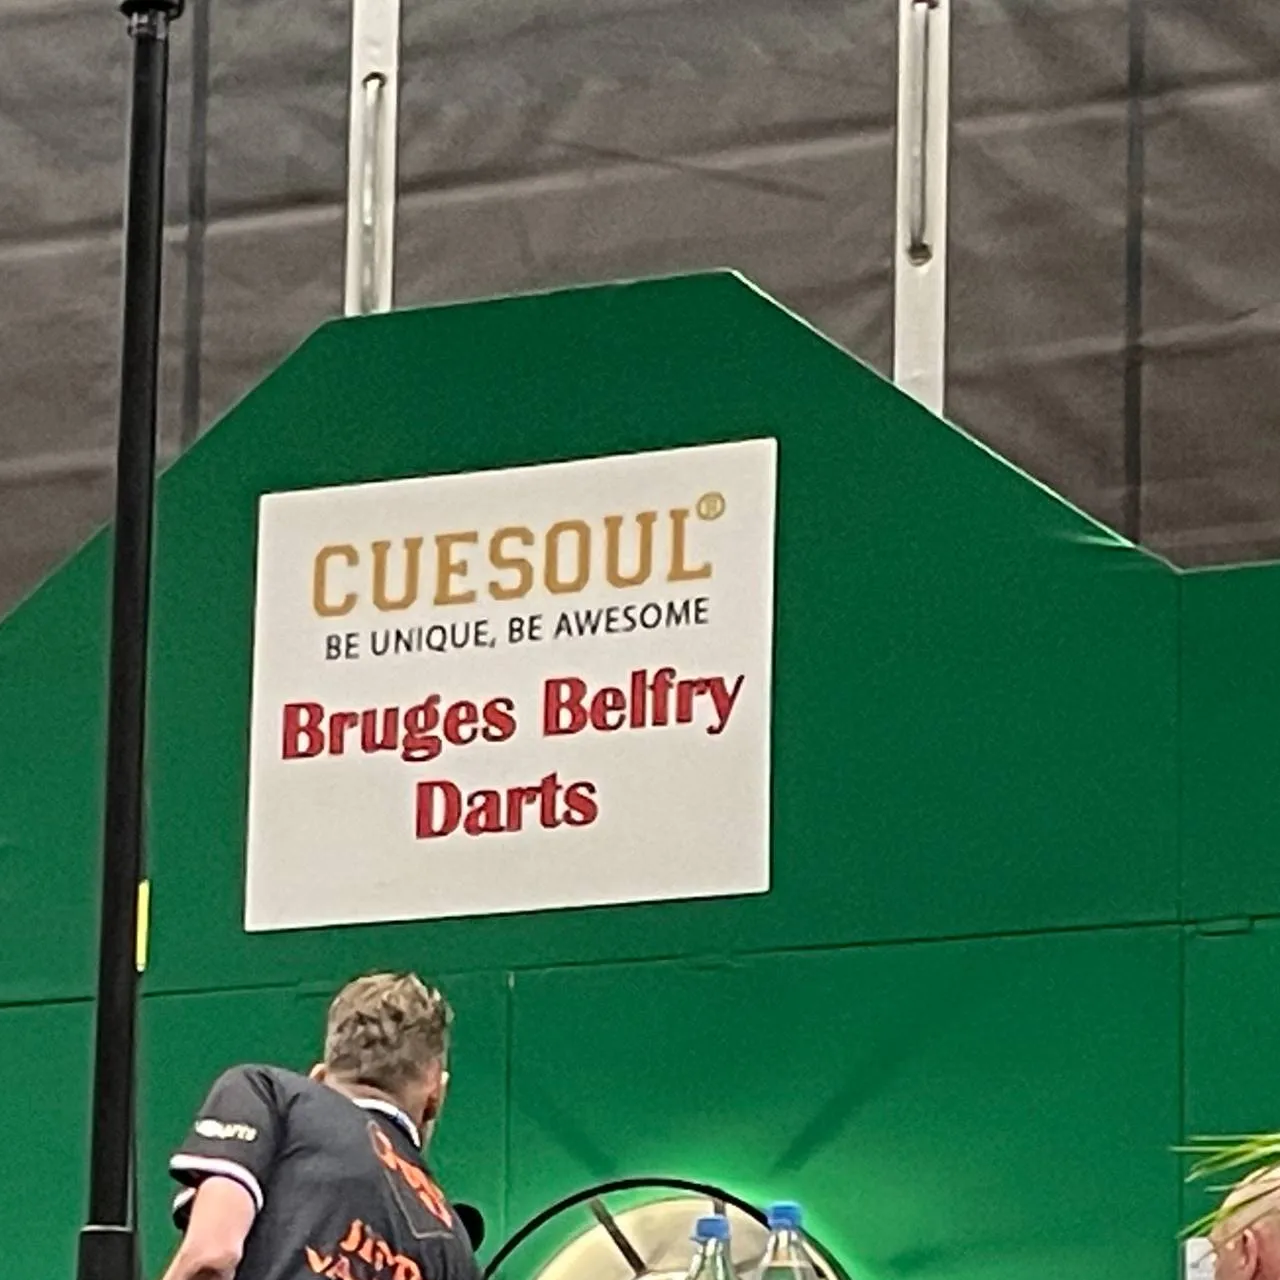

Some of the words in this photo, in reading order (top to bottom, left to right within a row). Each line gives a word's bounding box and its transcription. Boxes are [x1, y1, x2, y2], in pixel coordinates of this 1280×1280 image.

[325, 632, 360, 661] BE
[371, 619, 496, 657] UNIQUE,
[507, 616, 543, 643] BE
[554, 597, 710, 641] AWESOME
[282, 694, 517, 762] Bruges
[543, 667, 745, 738] Belfry
[416, 772, 599, 839] Darts
